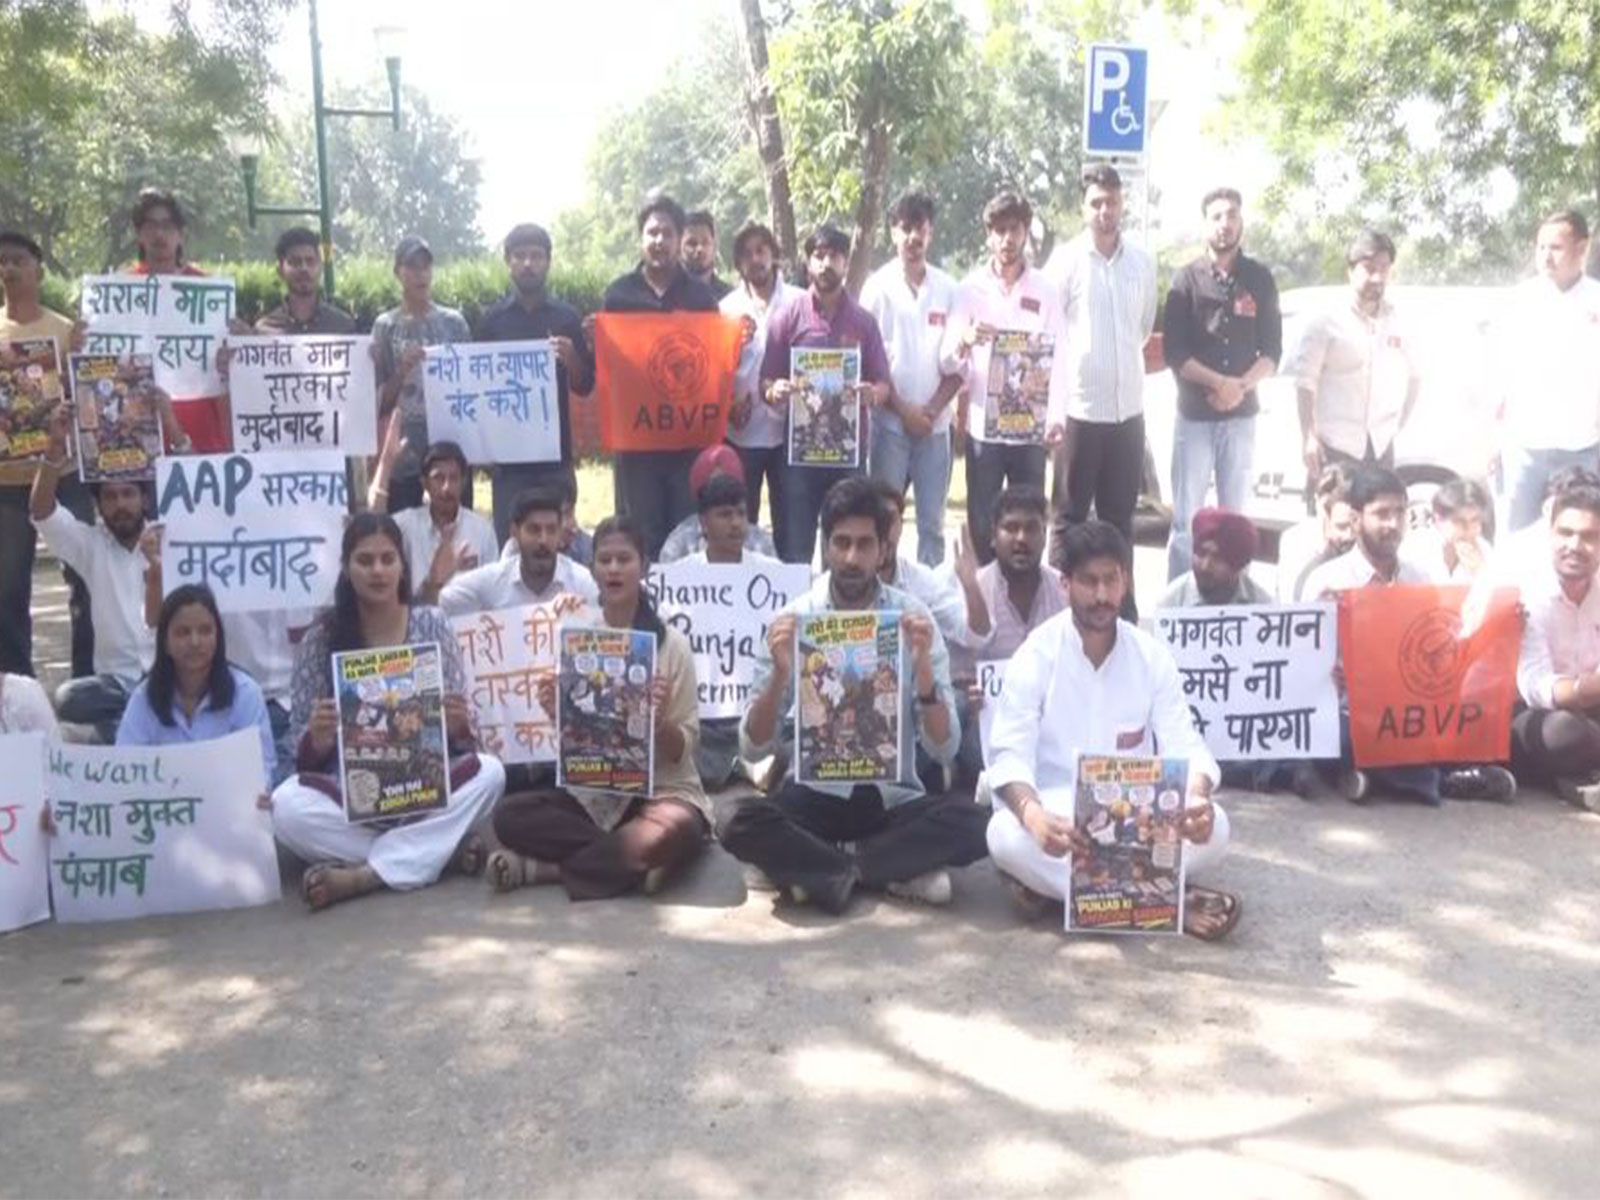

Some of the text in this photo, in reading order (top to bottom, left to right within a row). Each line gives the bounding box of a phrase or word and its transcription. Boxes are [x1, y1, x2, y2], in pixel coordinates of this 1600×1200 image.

[1092, 49, 1131, 113] P
[88, 275, 234, 327] शराबी मान
[156, 335, 215, 371] हाय
[303, 341, 357, 368] मान
[264, 371, 351, 403] सरकार
[633, 402, 721, 431] ABVP
[159, 455, 253, 517] AAP
[645, 572, 787, 610] Shame On
[668, 613, 767, 675] Punja
[1252, 610, 1326, 649] मान
[1178, 654, 1289, 702] मसे ना
[1377, 703, 1483, 740] ABVP
[54, 797, 203, 844] नशा मुक्त
[53, 852, 154, 899] पंजाब
